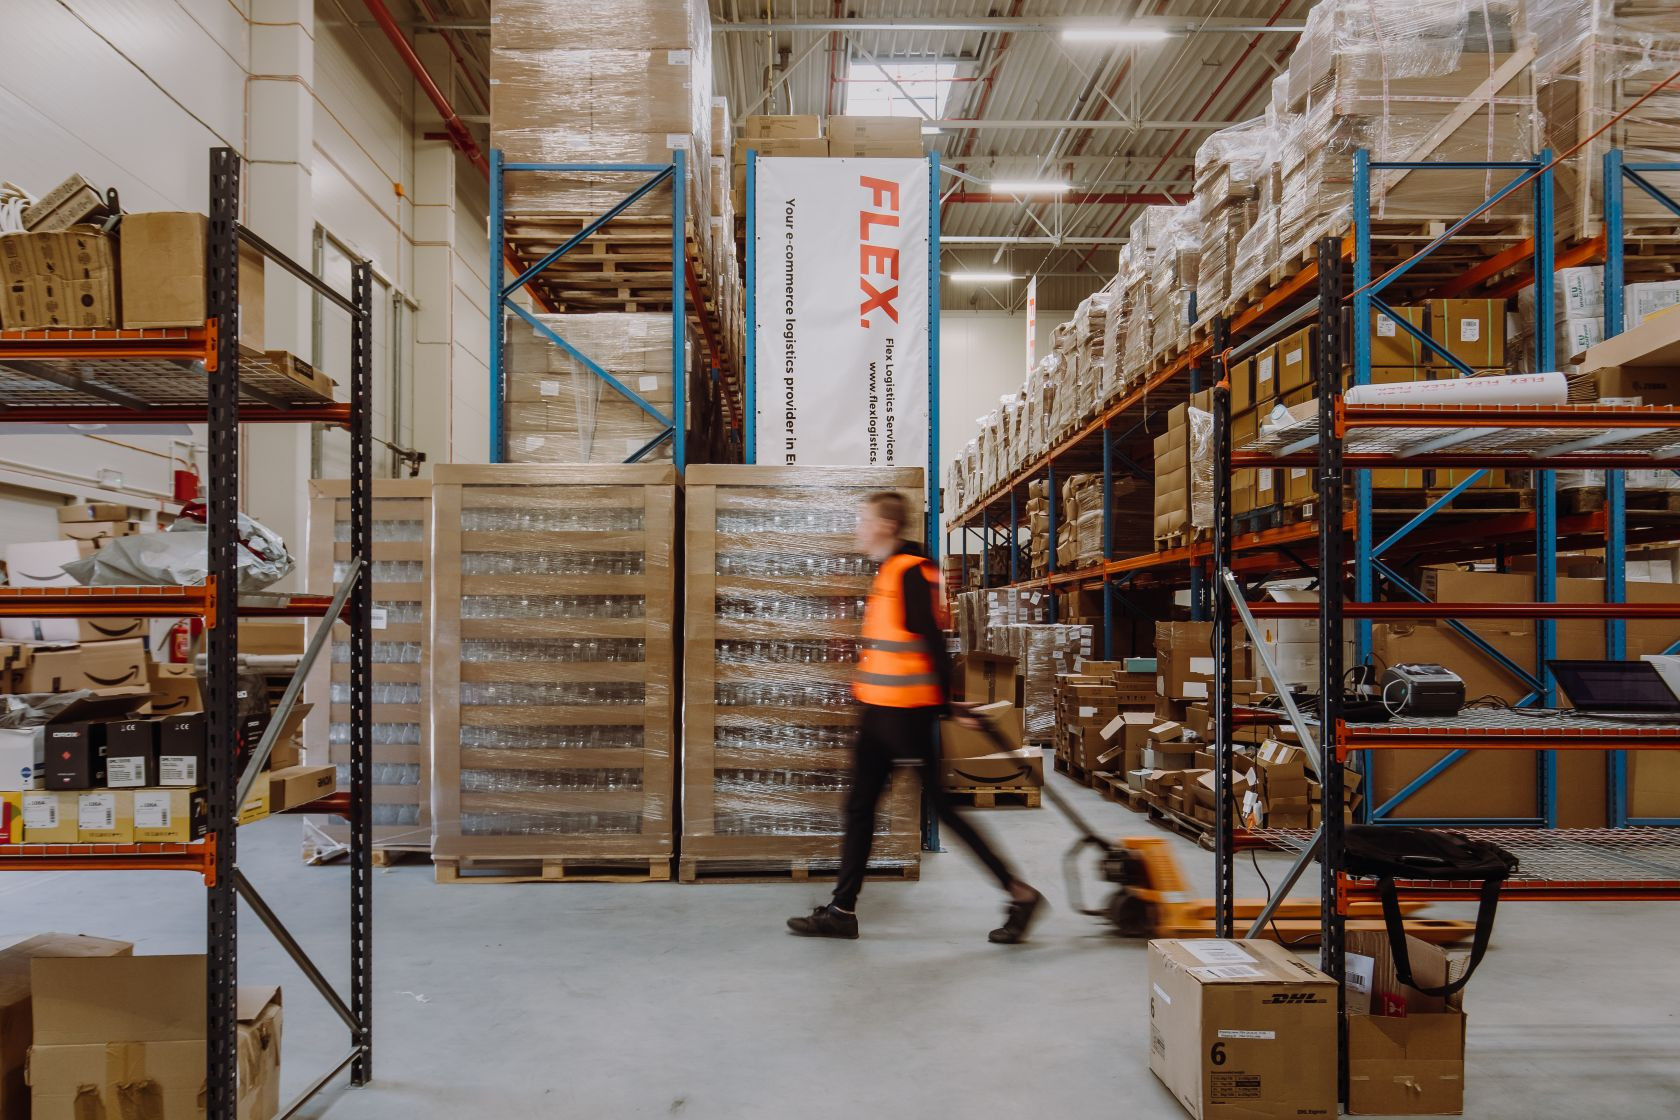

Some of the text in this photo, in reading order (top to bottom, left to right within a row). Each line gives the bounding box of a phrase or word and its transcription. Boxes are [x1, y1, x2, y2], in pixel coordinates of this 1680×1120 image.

[785, 198, 796, 229] Your
[785, 233, 794, 315] e-commerce
[783, 318, 796, 374] logistics
[885, 338, 894, 361] Flex
[884, 364, 895, 413] Logistics
[783, 377, 797, 435] provider
[785, 438, 797, 450] in
[886, 416, 896, 462] Services
[1150, 997, 1156, 1019] 6
[1271, 993, 1317, 1004] DHL
[1210, 1041, 1227, 1066] 6
